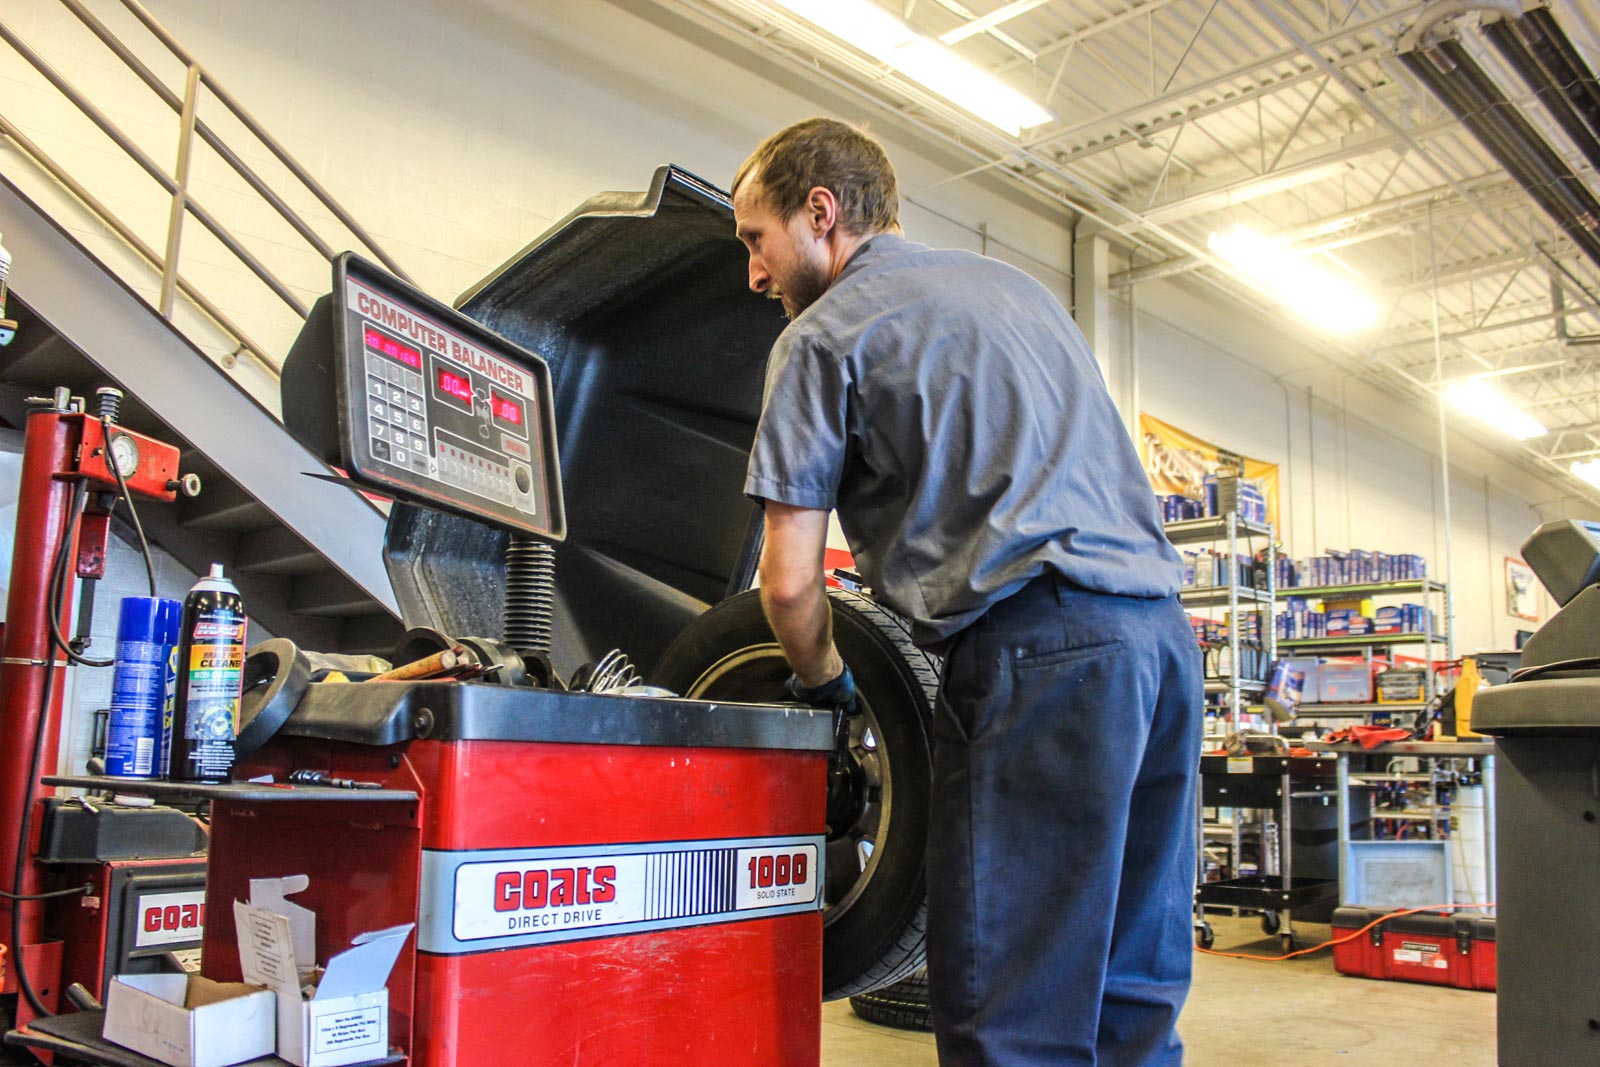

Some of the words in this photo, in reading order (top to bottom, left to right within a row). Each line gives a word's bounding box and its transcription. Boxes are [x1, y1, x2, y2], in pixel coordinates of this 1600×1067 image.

[358, 292, 447, 354] COMPUTER
[452, 340, 524, 394] BALANCER
[374, 383, 382, 395] 1
[392, 391, 402, 403] 2
[411, 399, 420, 411] 3
[374, 403, 384, 415] 4
[393, 411, 402, 423] 5
[412, 419, 421, 431] 6
[375, 424, 384, 436] 7
[395, 432, 404, 444] 8
[414, 439, 422, 451] 9
[396, 450, 405, 462] 0
[748, 853, 807, 889] 1000
[757, 890, 775, 900] SOLID
[776, 888, 796, 897] STATE
[508, 913, 558, 929] DIRECT
[563, 909, 602, 923] DRIVE
